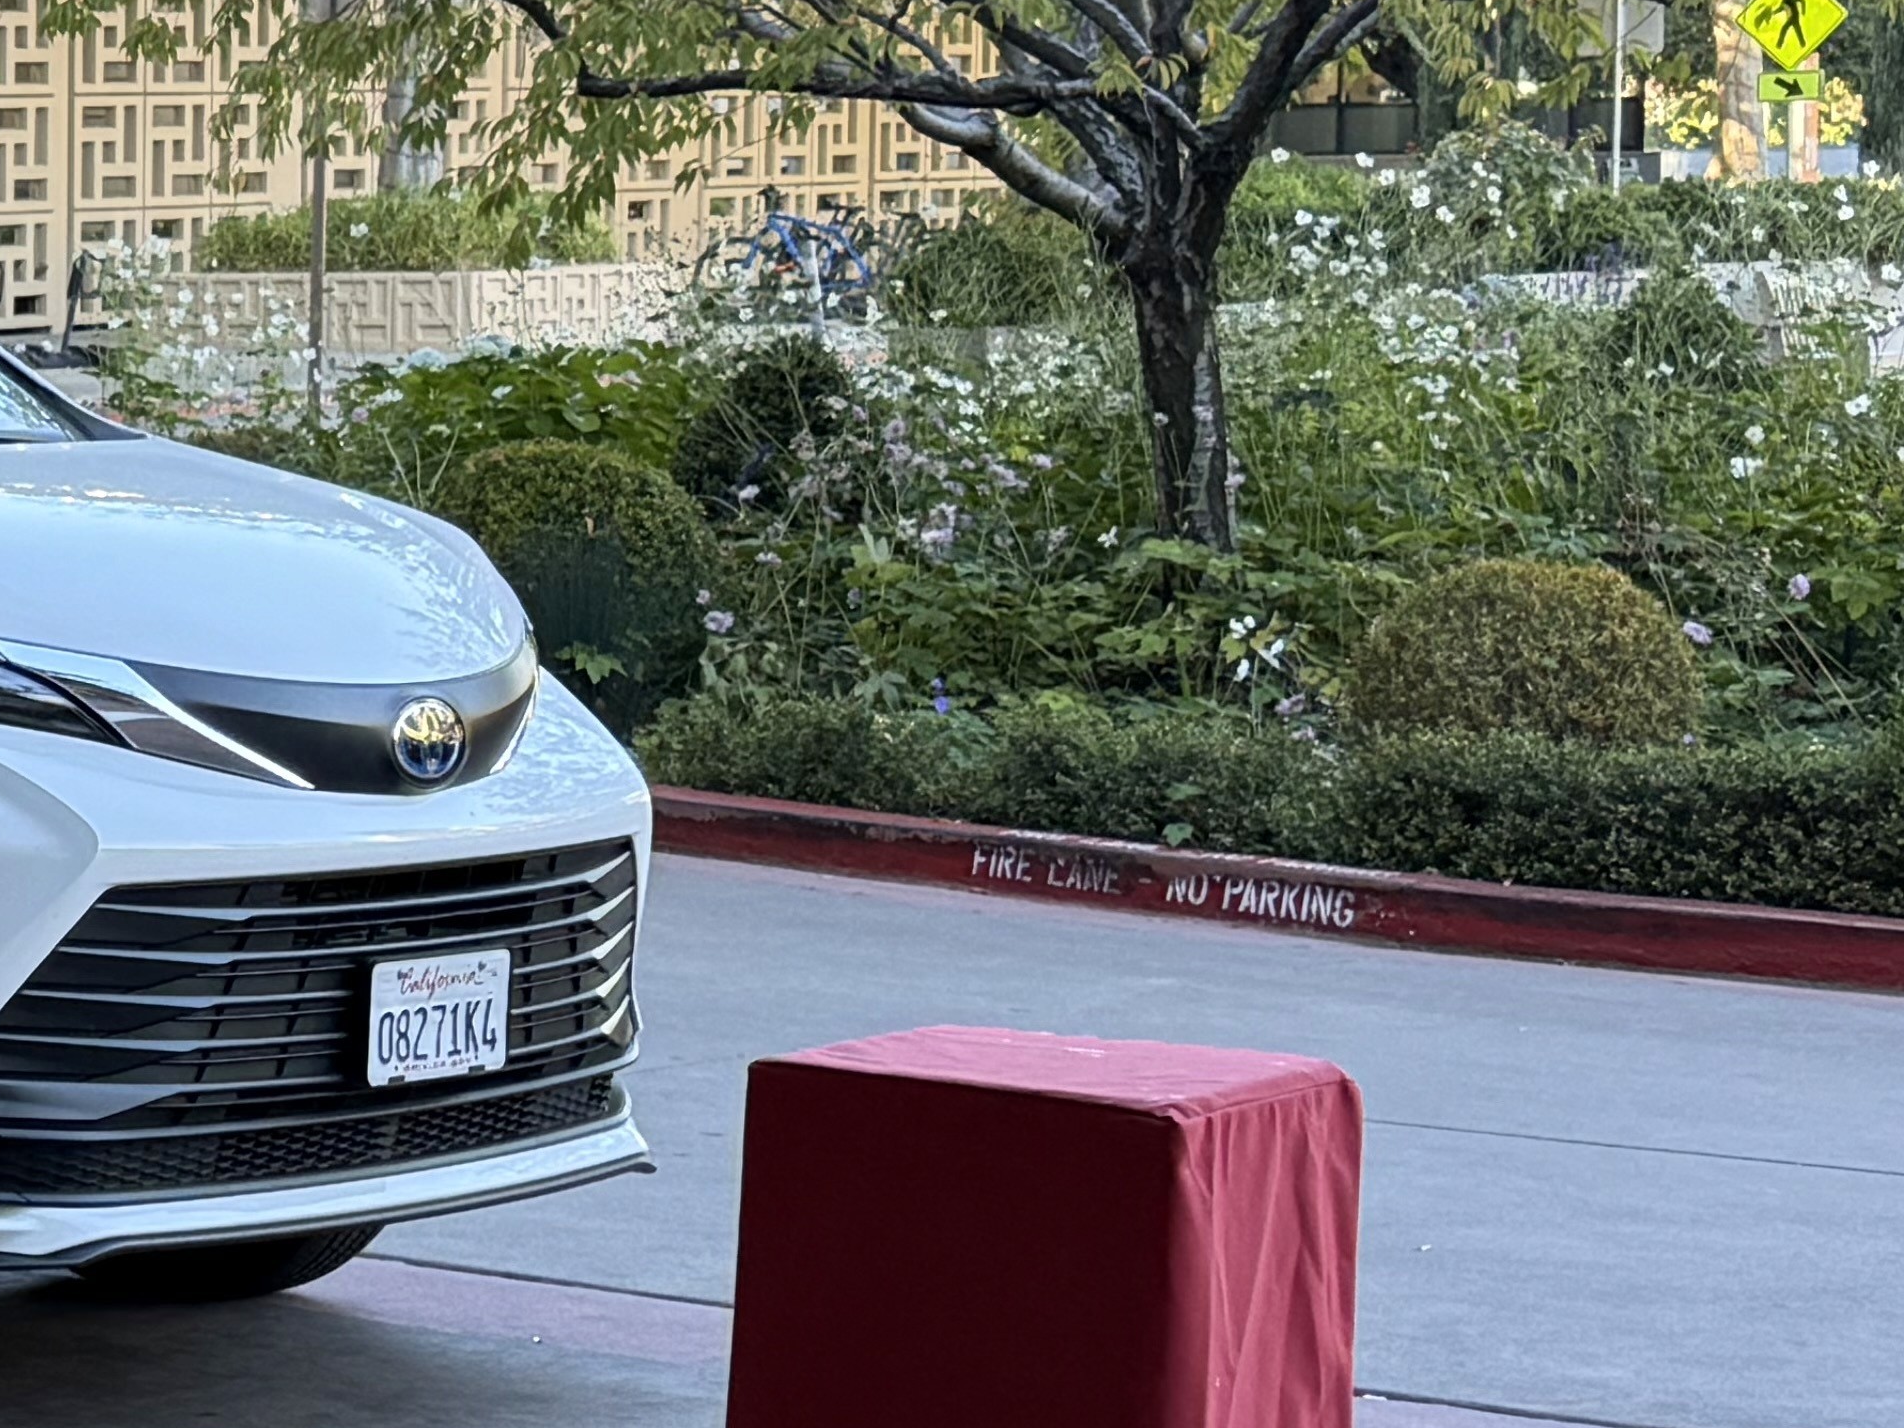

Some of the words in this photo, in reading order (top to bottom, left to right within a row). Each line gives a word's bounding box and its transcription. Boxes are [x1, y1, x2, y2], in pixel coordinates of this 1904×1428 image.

[972, 843, 1033, 883] FIRE
[1047, 853, 1123, 894] LANE
[1165, 873, 1209, 905] NO
[1221, 875, 1355, 928] PARKING
[399, 965, 485, 999] California
[378, 998, 497, 1065] 08271K4
